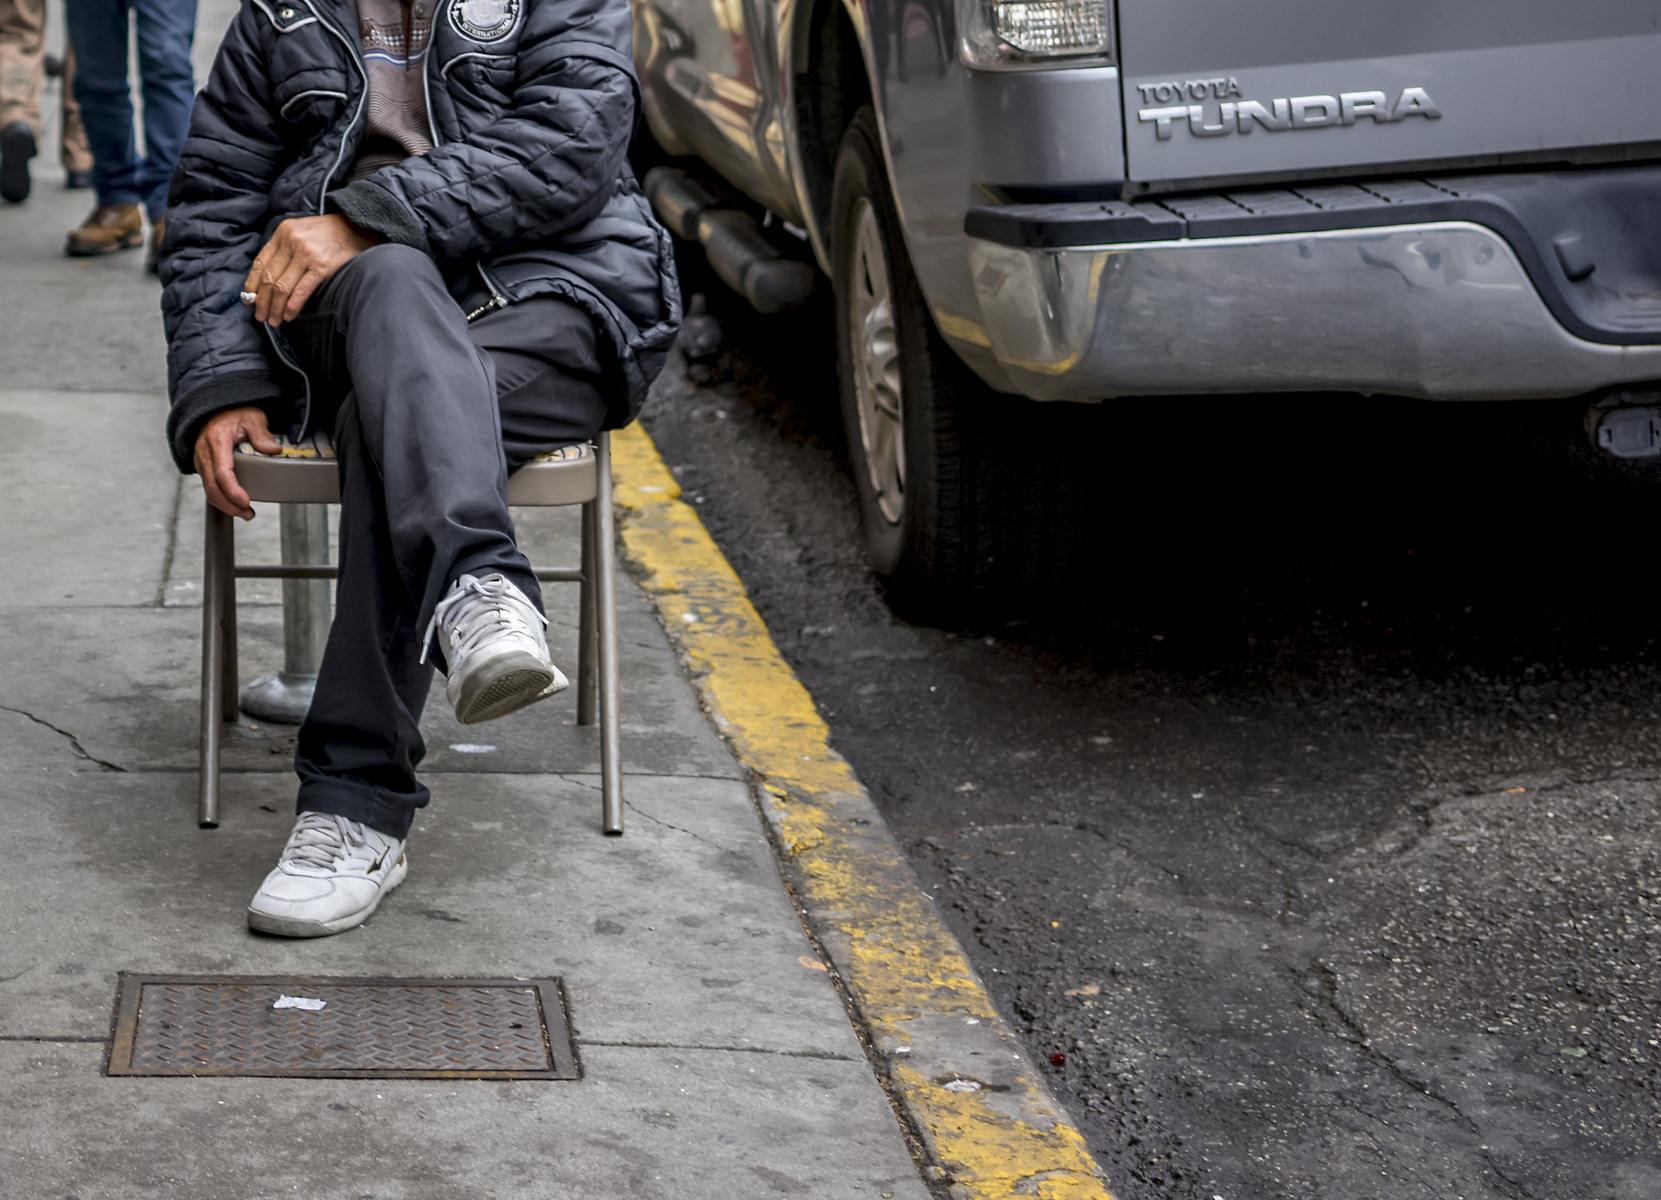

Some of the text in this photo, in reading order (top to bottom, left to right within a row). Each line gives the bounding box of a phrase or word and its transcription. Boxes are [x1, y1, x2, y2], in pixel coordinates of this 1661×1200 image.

[462, 19, 511, 37] INTERNATIONAL
[1137, 76, 1242, 103] TOYOTA
[1138, 86, 1442, 141] TUNDRA
